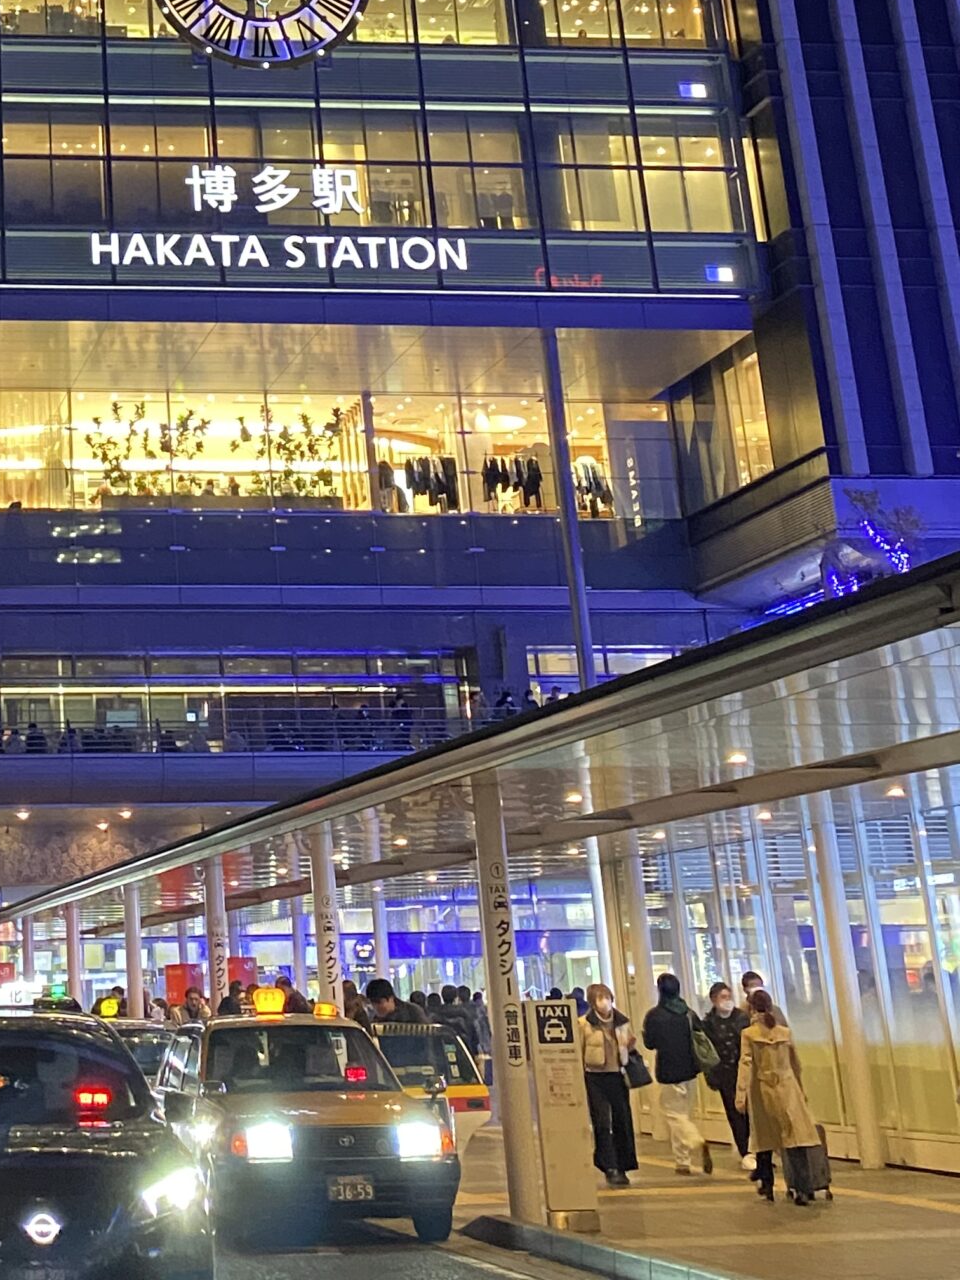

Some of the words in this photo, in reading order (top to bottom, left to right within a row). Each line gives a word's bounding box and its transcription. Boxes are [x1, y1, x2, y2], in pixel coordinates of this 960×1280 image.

[185, 164, 366, 214] 博多駅
[91, 233, 270, 268] HAKATA
[284, 235, 468, 270] STATION
[538, 1006, 568, 1017] TAXI
